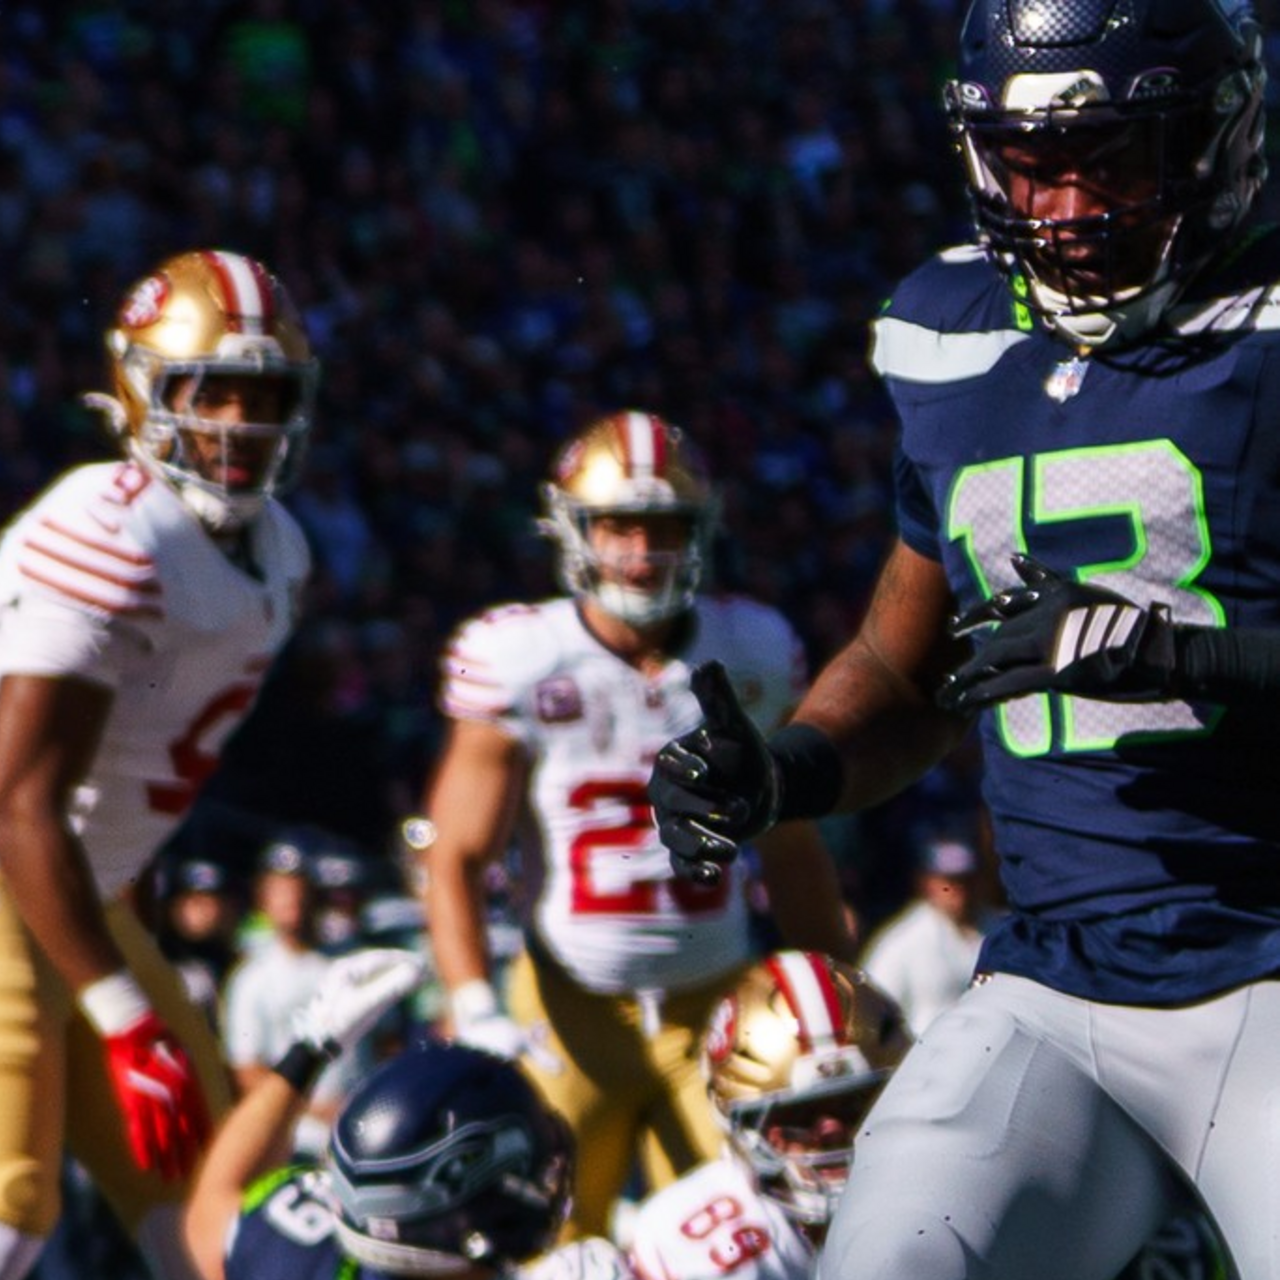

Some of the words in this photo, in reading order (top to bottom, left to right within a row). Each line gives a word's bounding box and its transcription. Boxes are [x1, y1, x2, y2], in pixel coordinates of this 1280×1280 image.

[947, 437, 1227, 758] 13
[569, 781, 731, 914] 2
[681, 1198, 769, 1273] 89
